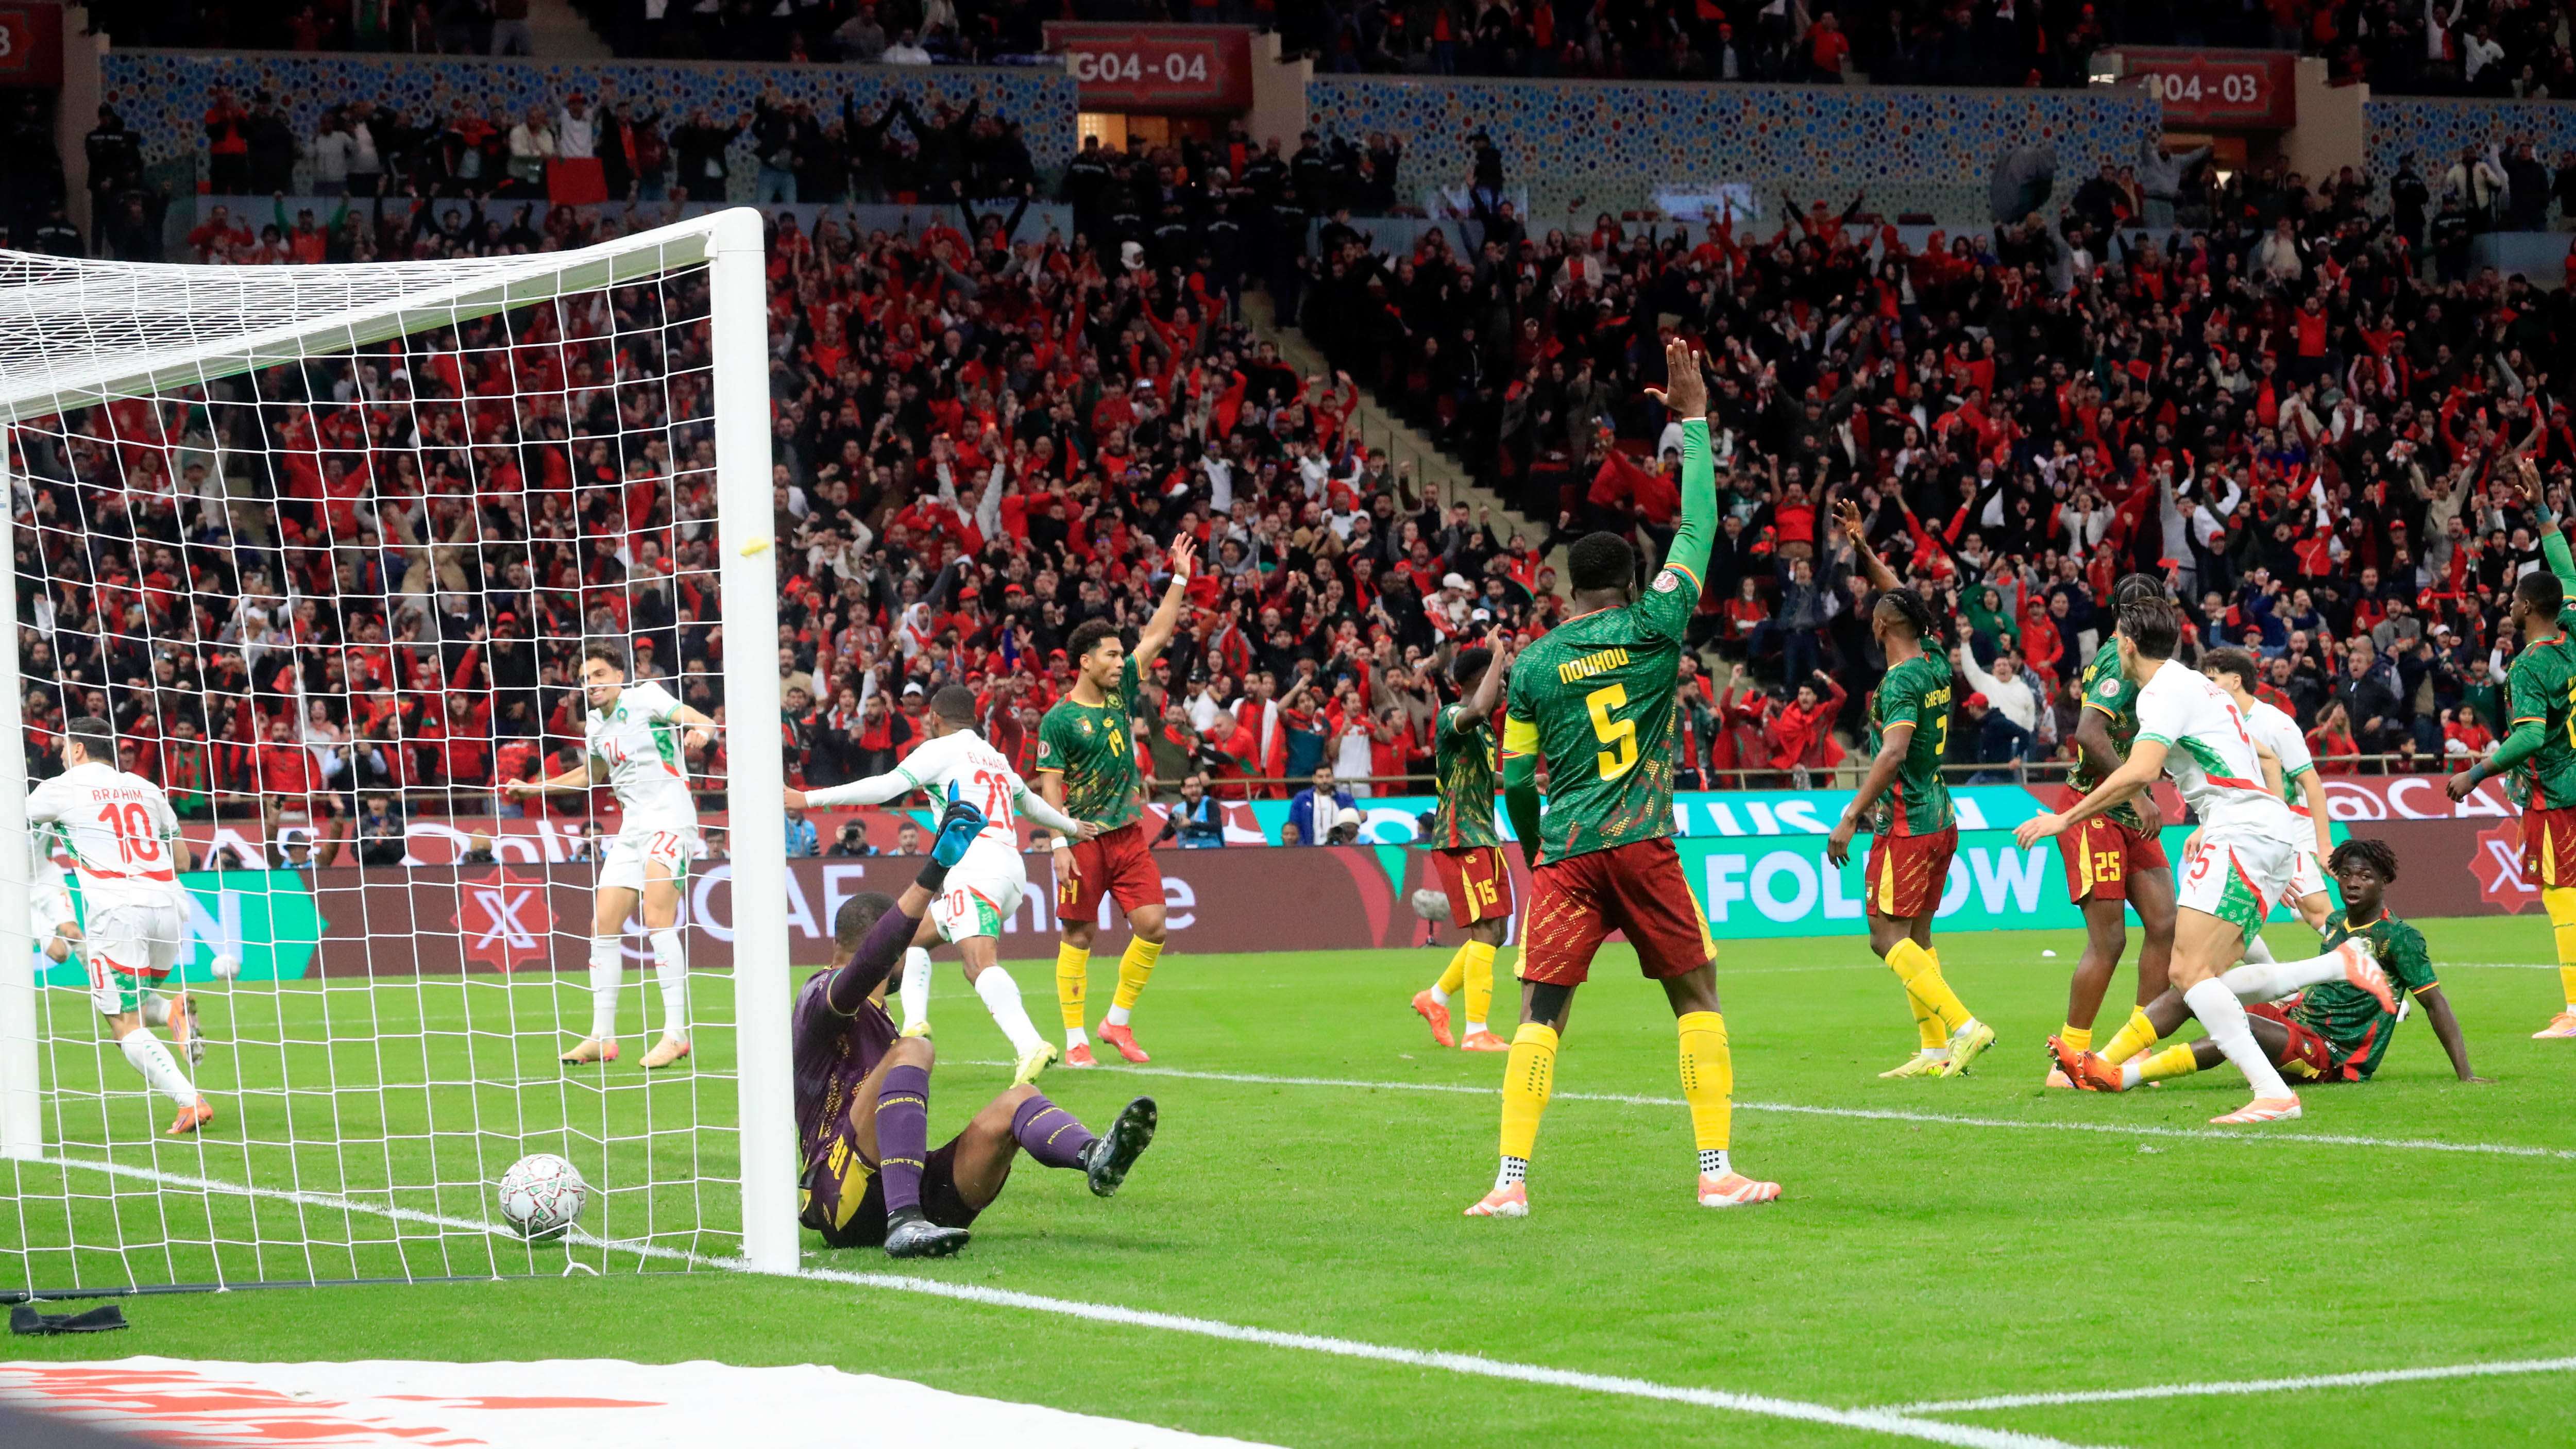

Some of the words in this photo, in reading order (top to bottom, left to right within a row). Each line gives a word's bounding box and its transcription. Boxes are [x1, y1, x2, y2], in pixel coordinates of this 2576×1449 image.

[2164, 74, 2257, 102] 04-03
[1558, 647, 1630, 684] NOUHOU
[1108, 728, 1125, 757] 14
[1585, 682, 1639, 782] 5
[604, 737, 626, 767] 24
[967, 752, 980, 765] EL
[92, 788, 143, 801] BRAHIM
[974, 769, 1014, 833] 20
[98, 803, 160, 865] 10
[650, 831, 679, 858] 24
[2094, 851, 2121, 882] 25
[2190, 843, 2216, 880] 5
[1475, 878, 1498, 906] 15
[1705, 846, 2048, 923] FOLOW
[945, 889, 964, 921] 20
